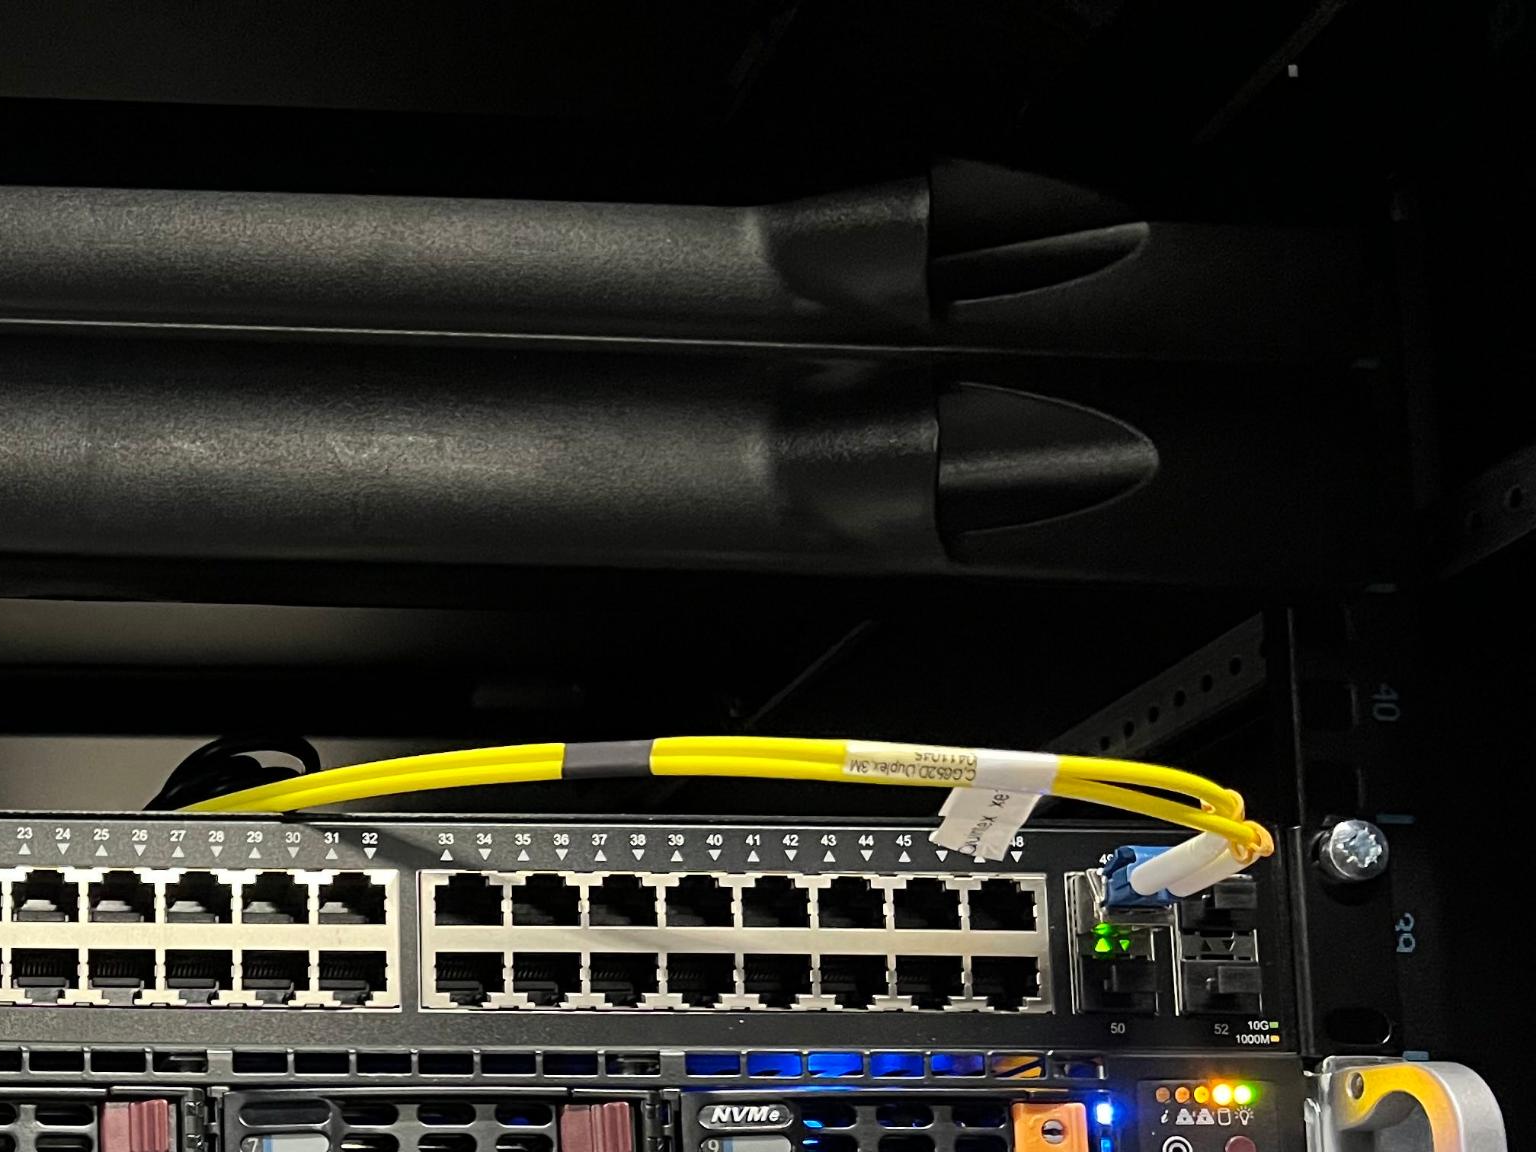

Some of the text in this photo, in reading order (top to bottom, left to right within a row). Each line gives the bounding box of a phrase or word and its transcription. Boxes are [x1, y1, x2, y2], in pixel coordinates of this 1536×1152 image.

[16, 826, 33, 840] 23
[55, 827, 71, 840] 24
[93, 828, 110, 841] 25
[131, 828, 148, 842] 26
[169, 829, 187, 842] 27
[208, 830, 225, 843] 28
[246, 830, 264, 843] 29
[285, 831, 301, 844] 30
[323, 831, 340, 844] 31
[361, 832, 379, 845] 32
[438, 832, 455, 845] 33
[476, 832, 493, 845] 34
[514, 833, 532, 846] 35
[553, 833, 570, 846] 36
[591, 833, 608, 846] 37
[629, 833, 647, 846] 38
[667, 833, 685, 846] 39
[705, 833, 723, 847] 40
[745, 834, 761, 846] 41
[782, 834, 799, 847] 42
[820, 834, 837, 847] 43
[858, 834, 875, 847] 44
[895, 834, 912, 847] 45
[1110, 1022, 1126, 1035] 50
[1214, 1023, 1230, 1036] 52
[1247, 1020, 1270, 1031] 10G
[1235, 1034, 1271, 1045] 1000M
[711, 1106, 780, 1122] NVMe
